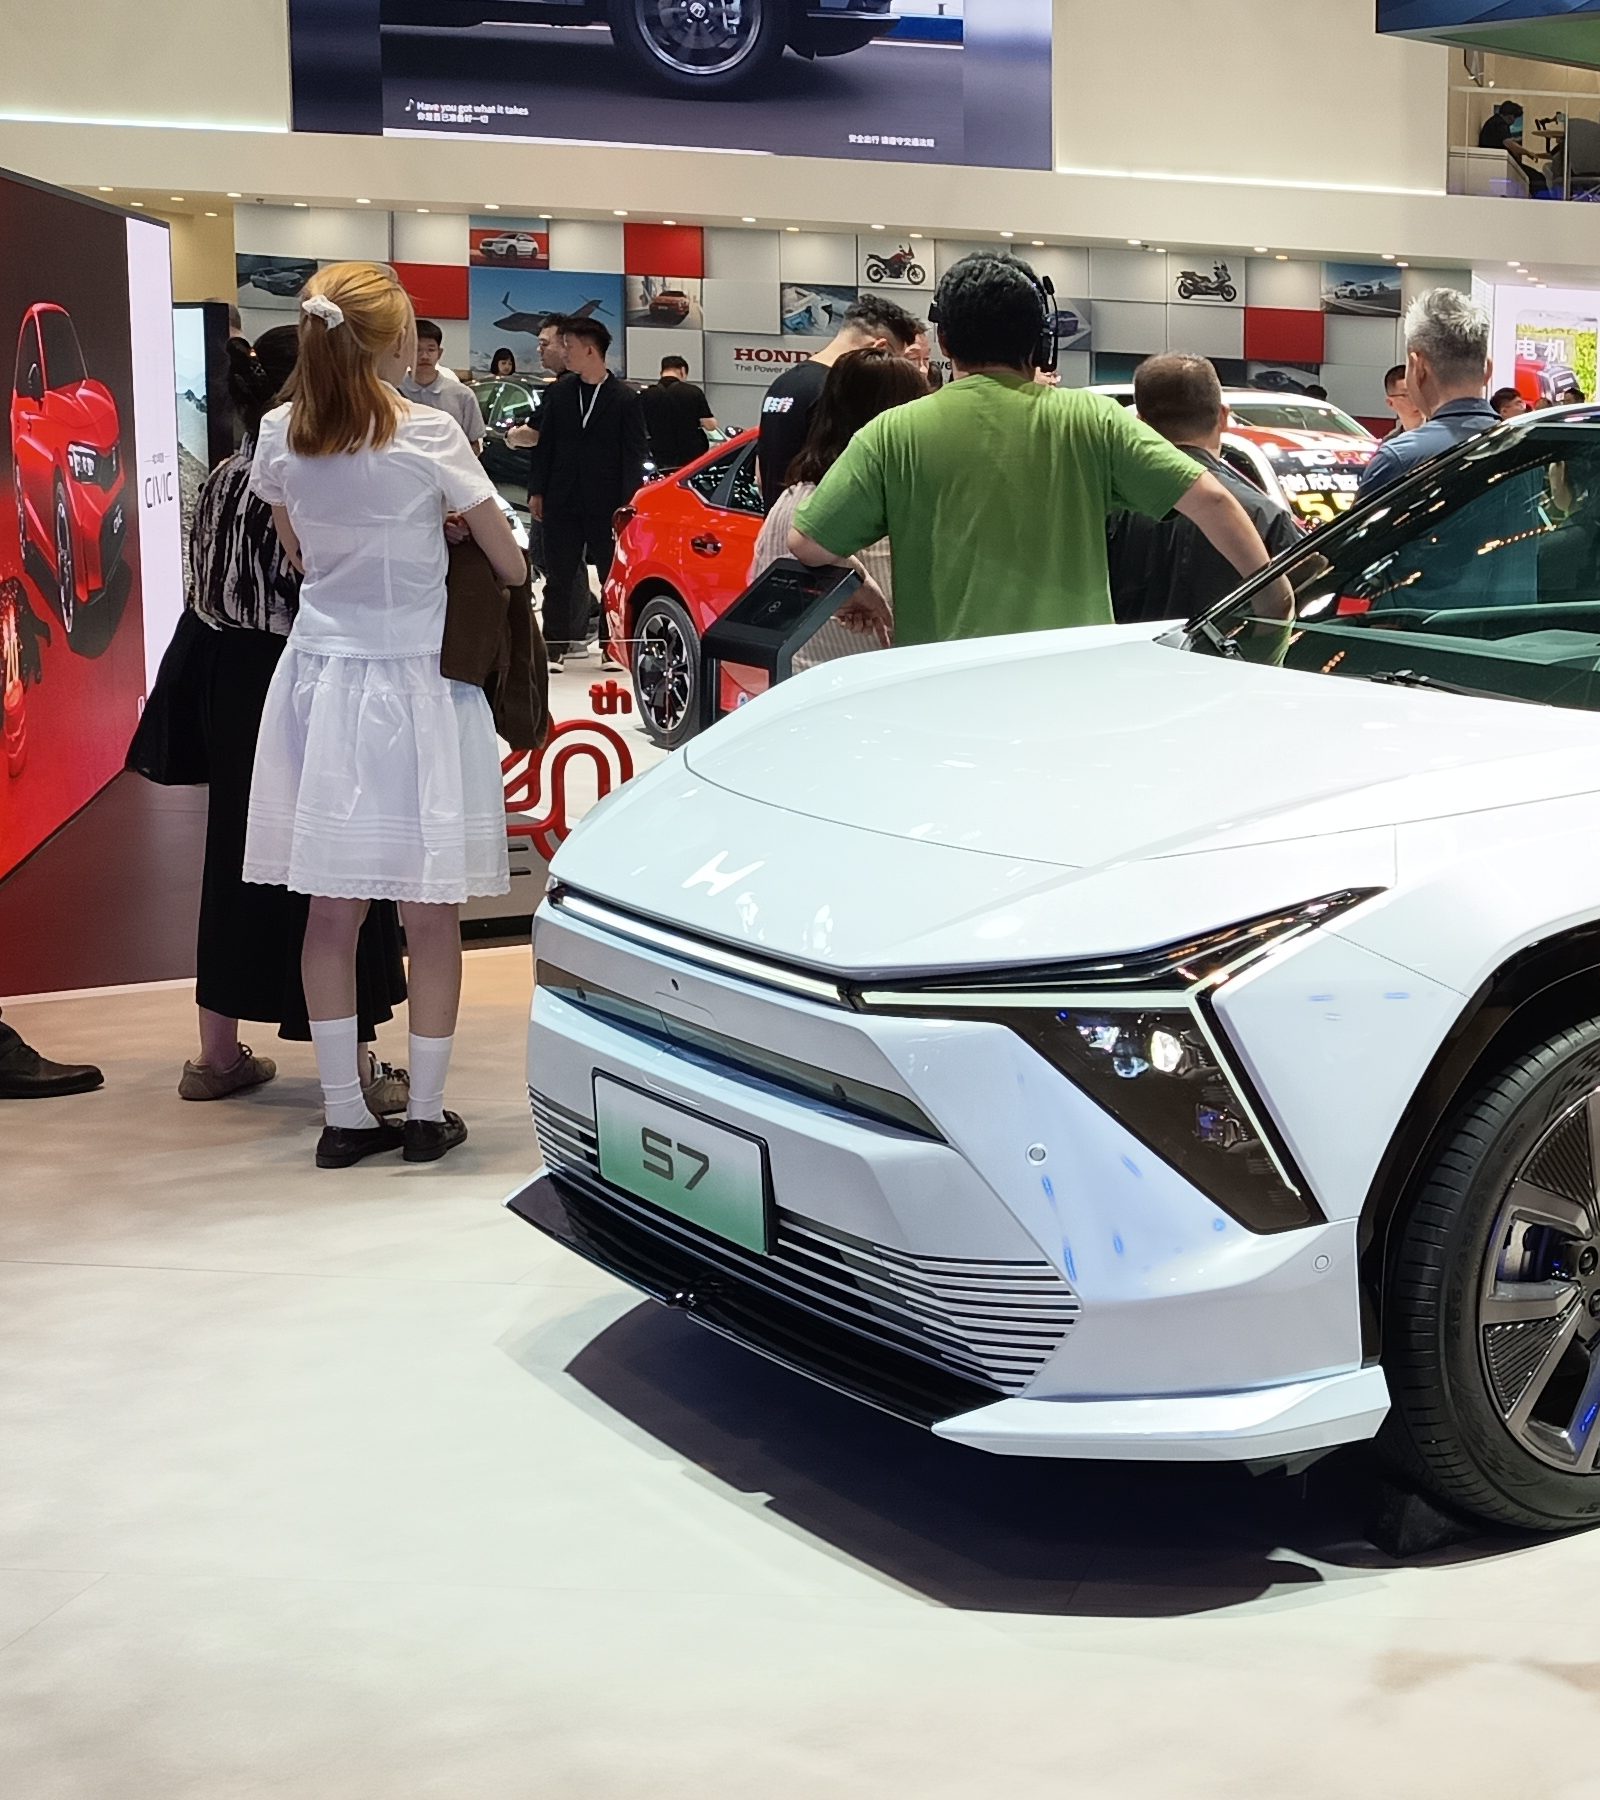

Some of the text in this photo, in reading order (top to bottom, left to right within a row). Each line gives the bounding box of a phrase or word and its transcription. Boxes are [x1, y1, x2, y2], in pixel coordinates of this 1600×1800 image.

[417, 101, 529, 116] Have you got what it takes
[734, 348, 813, 363] HOND
[735, 364, 752, 372] The
[753, 365, 782, 374] Power
[145, 472, 173, 508] CIVIC
[588, 680, 632, 715] th
[641, 1126, 710, 1191] S7
